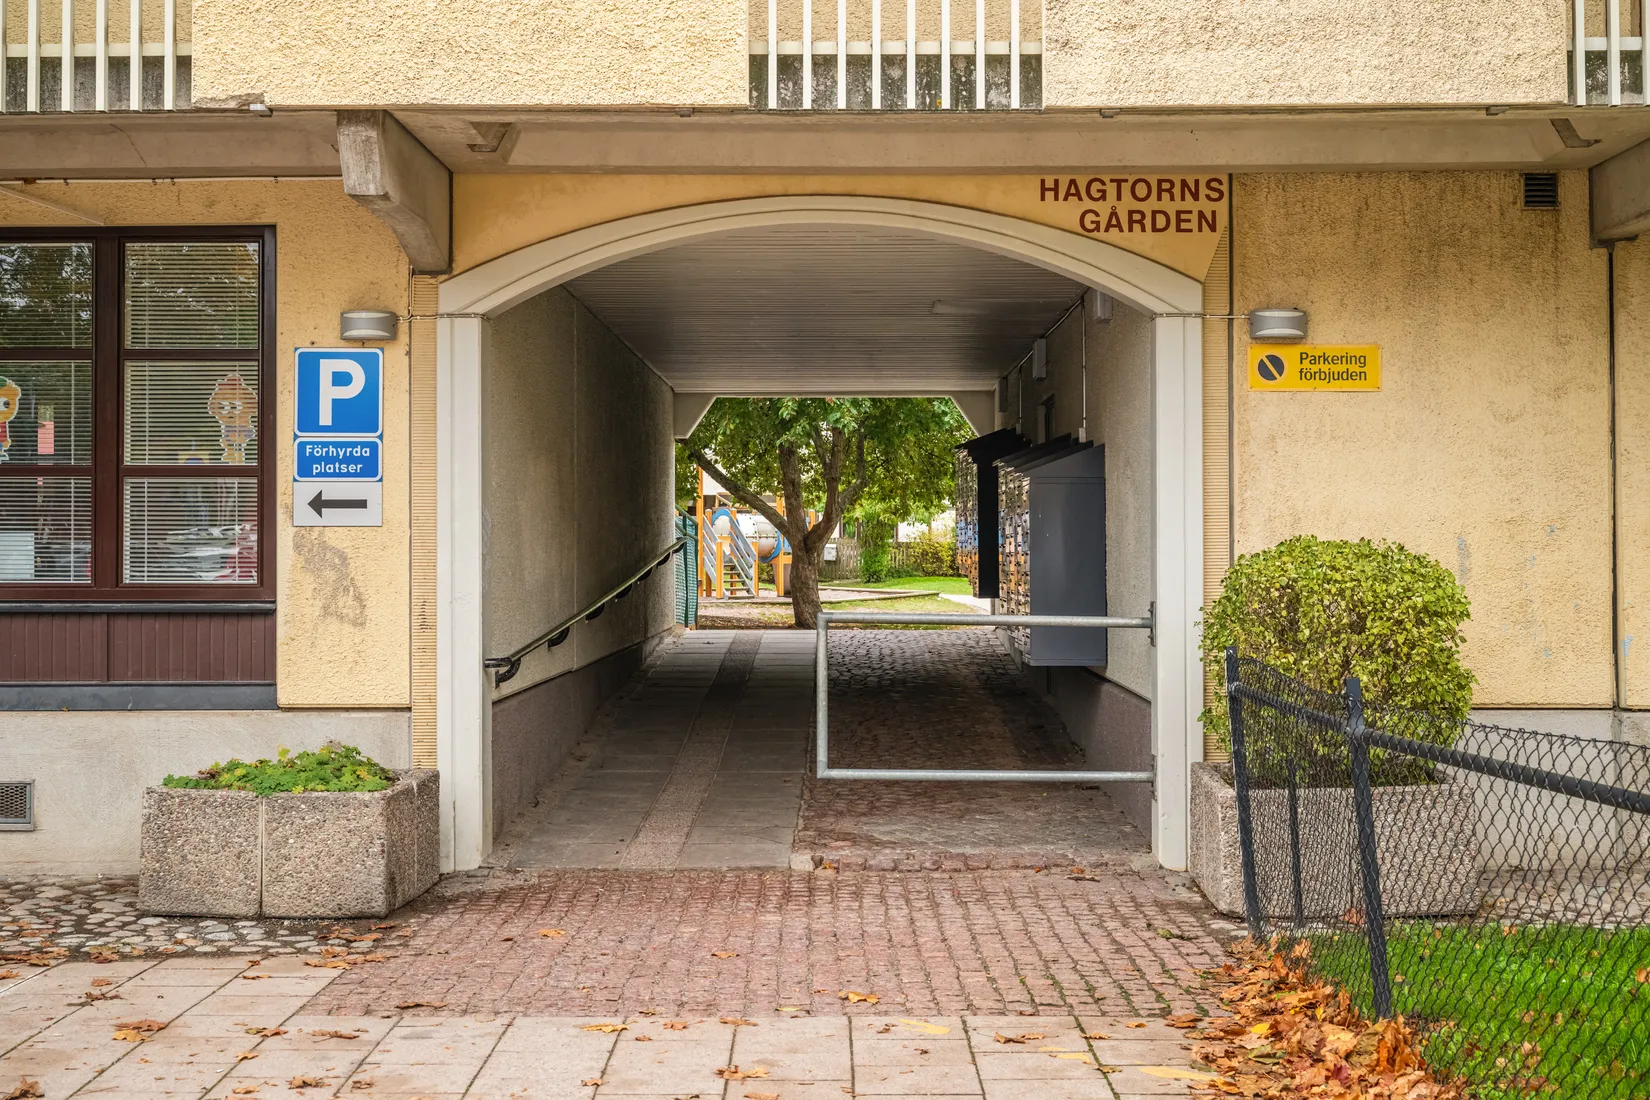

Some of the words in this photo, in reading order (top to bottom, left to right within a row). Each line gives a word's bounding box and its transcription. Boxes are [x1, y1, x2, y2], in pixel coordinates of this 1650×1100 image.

[1040, 177, 1225, 202] HAGTORNS
[1079, 205, 1217, 233] GÅRDEN
[1299, 352, 1367, 368] Parkering
[1299, 367, 1367, 384] förbjuden
[305, 445, 370, 459] Förhyrda
[312, 462, 363, 476] platser
